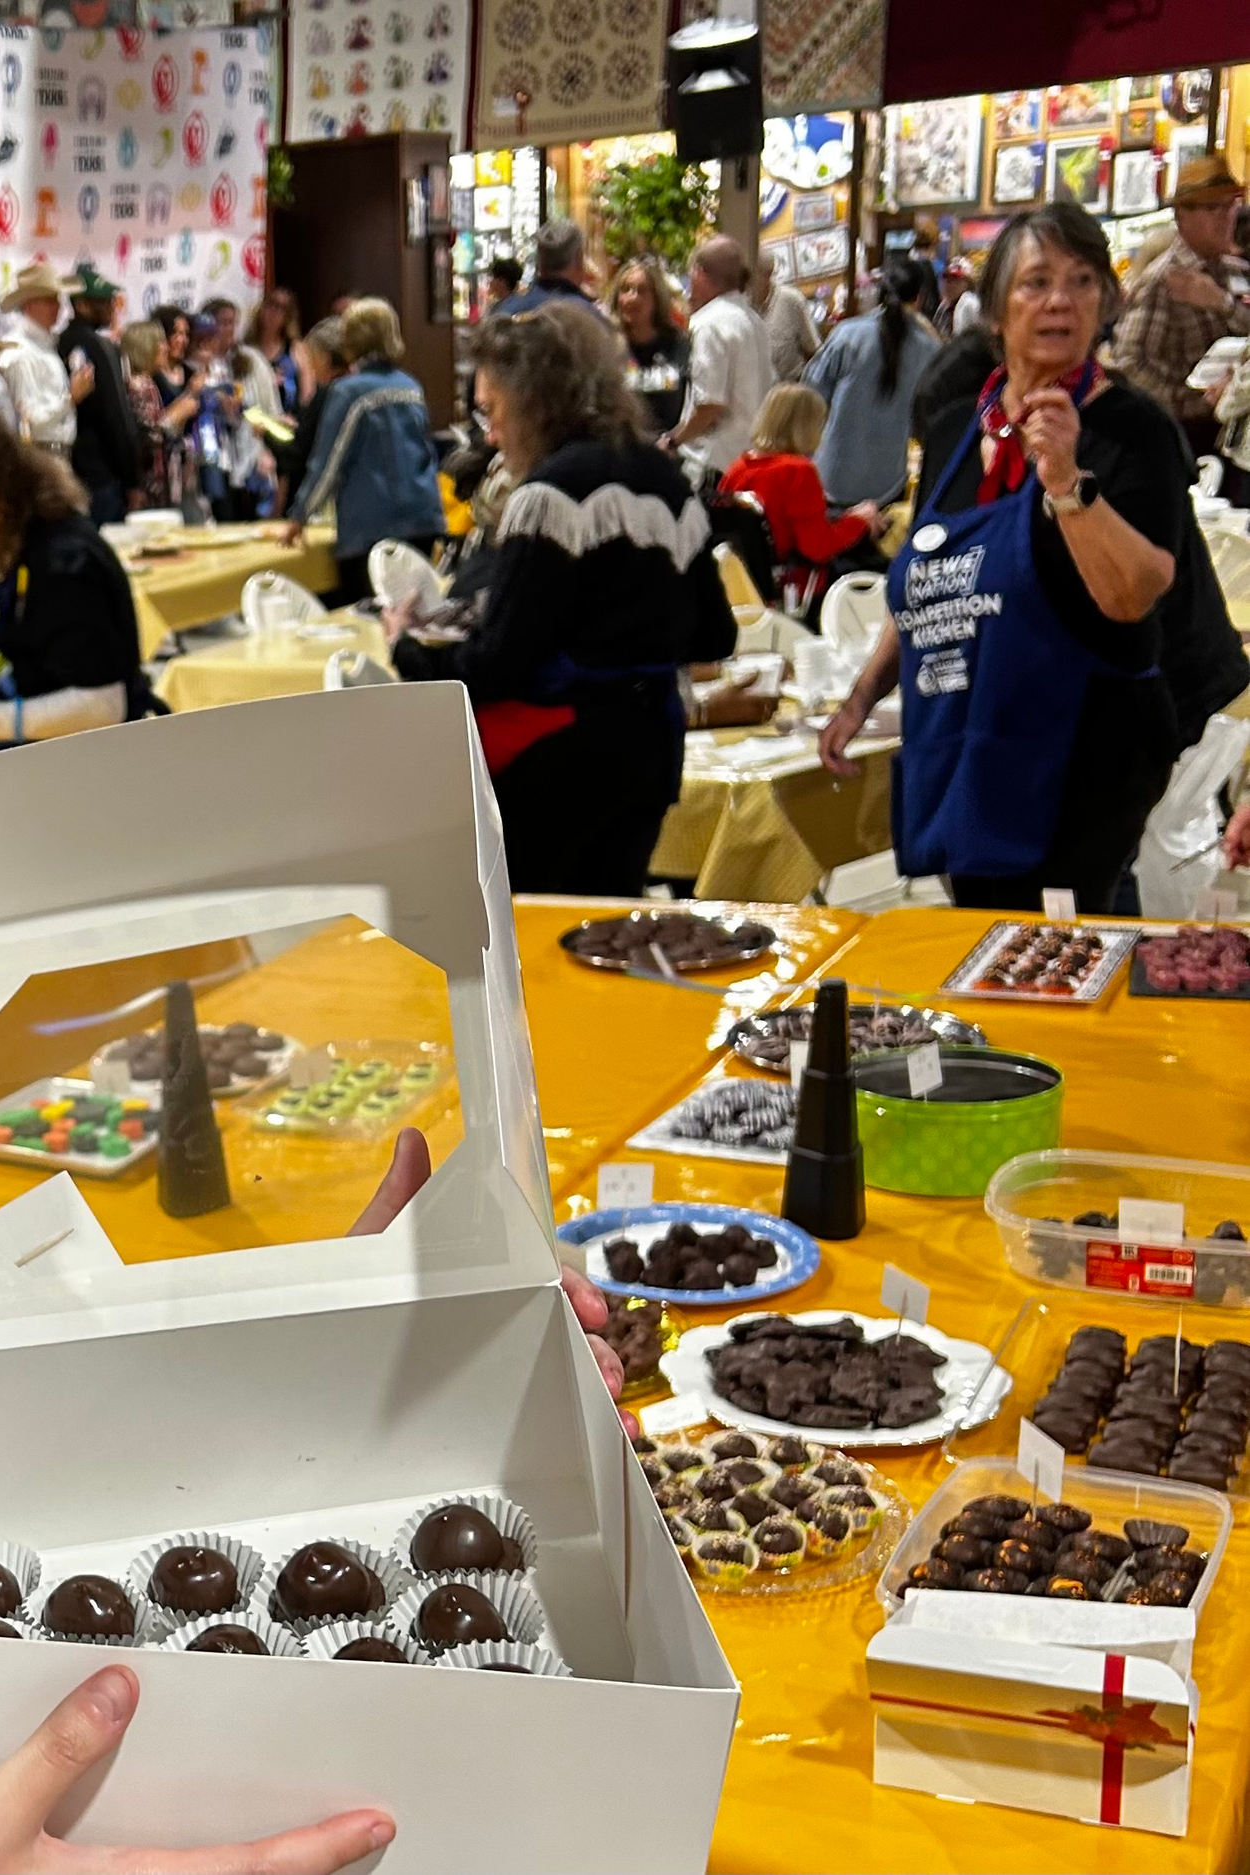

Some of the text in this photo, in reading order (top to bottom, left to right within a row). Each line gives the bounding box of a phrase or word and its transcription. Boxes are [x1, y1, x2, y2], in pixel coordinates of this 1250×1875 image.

[910, 566, 974, 601] NATION
[894, 592, 1003, 632] COMPETITION
[911, 615, 977, 650] KITCHEN
